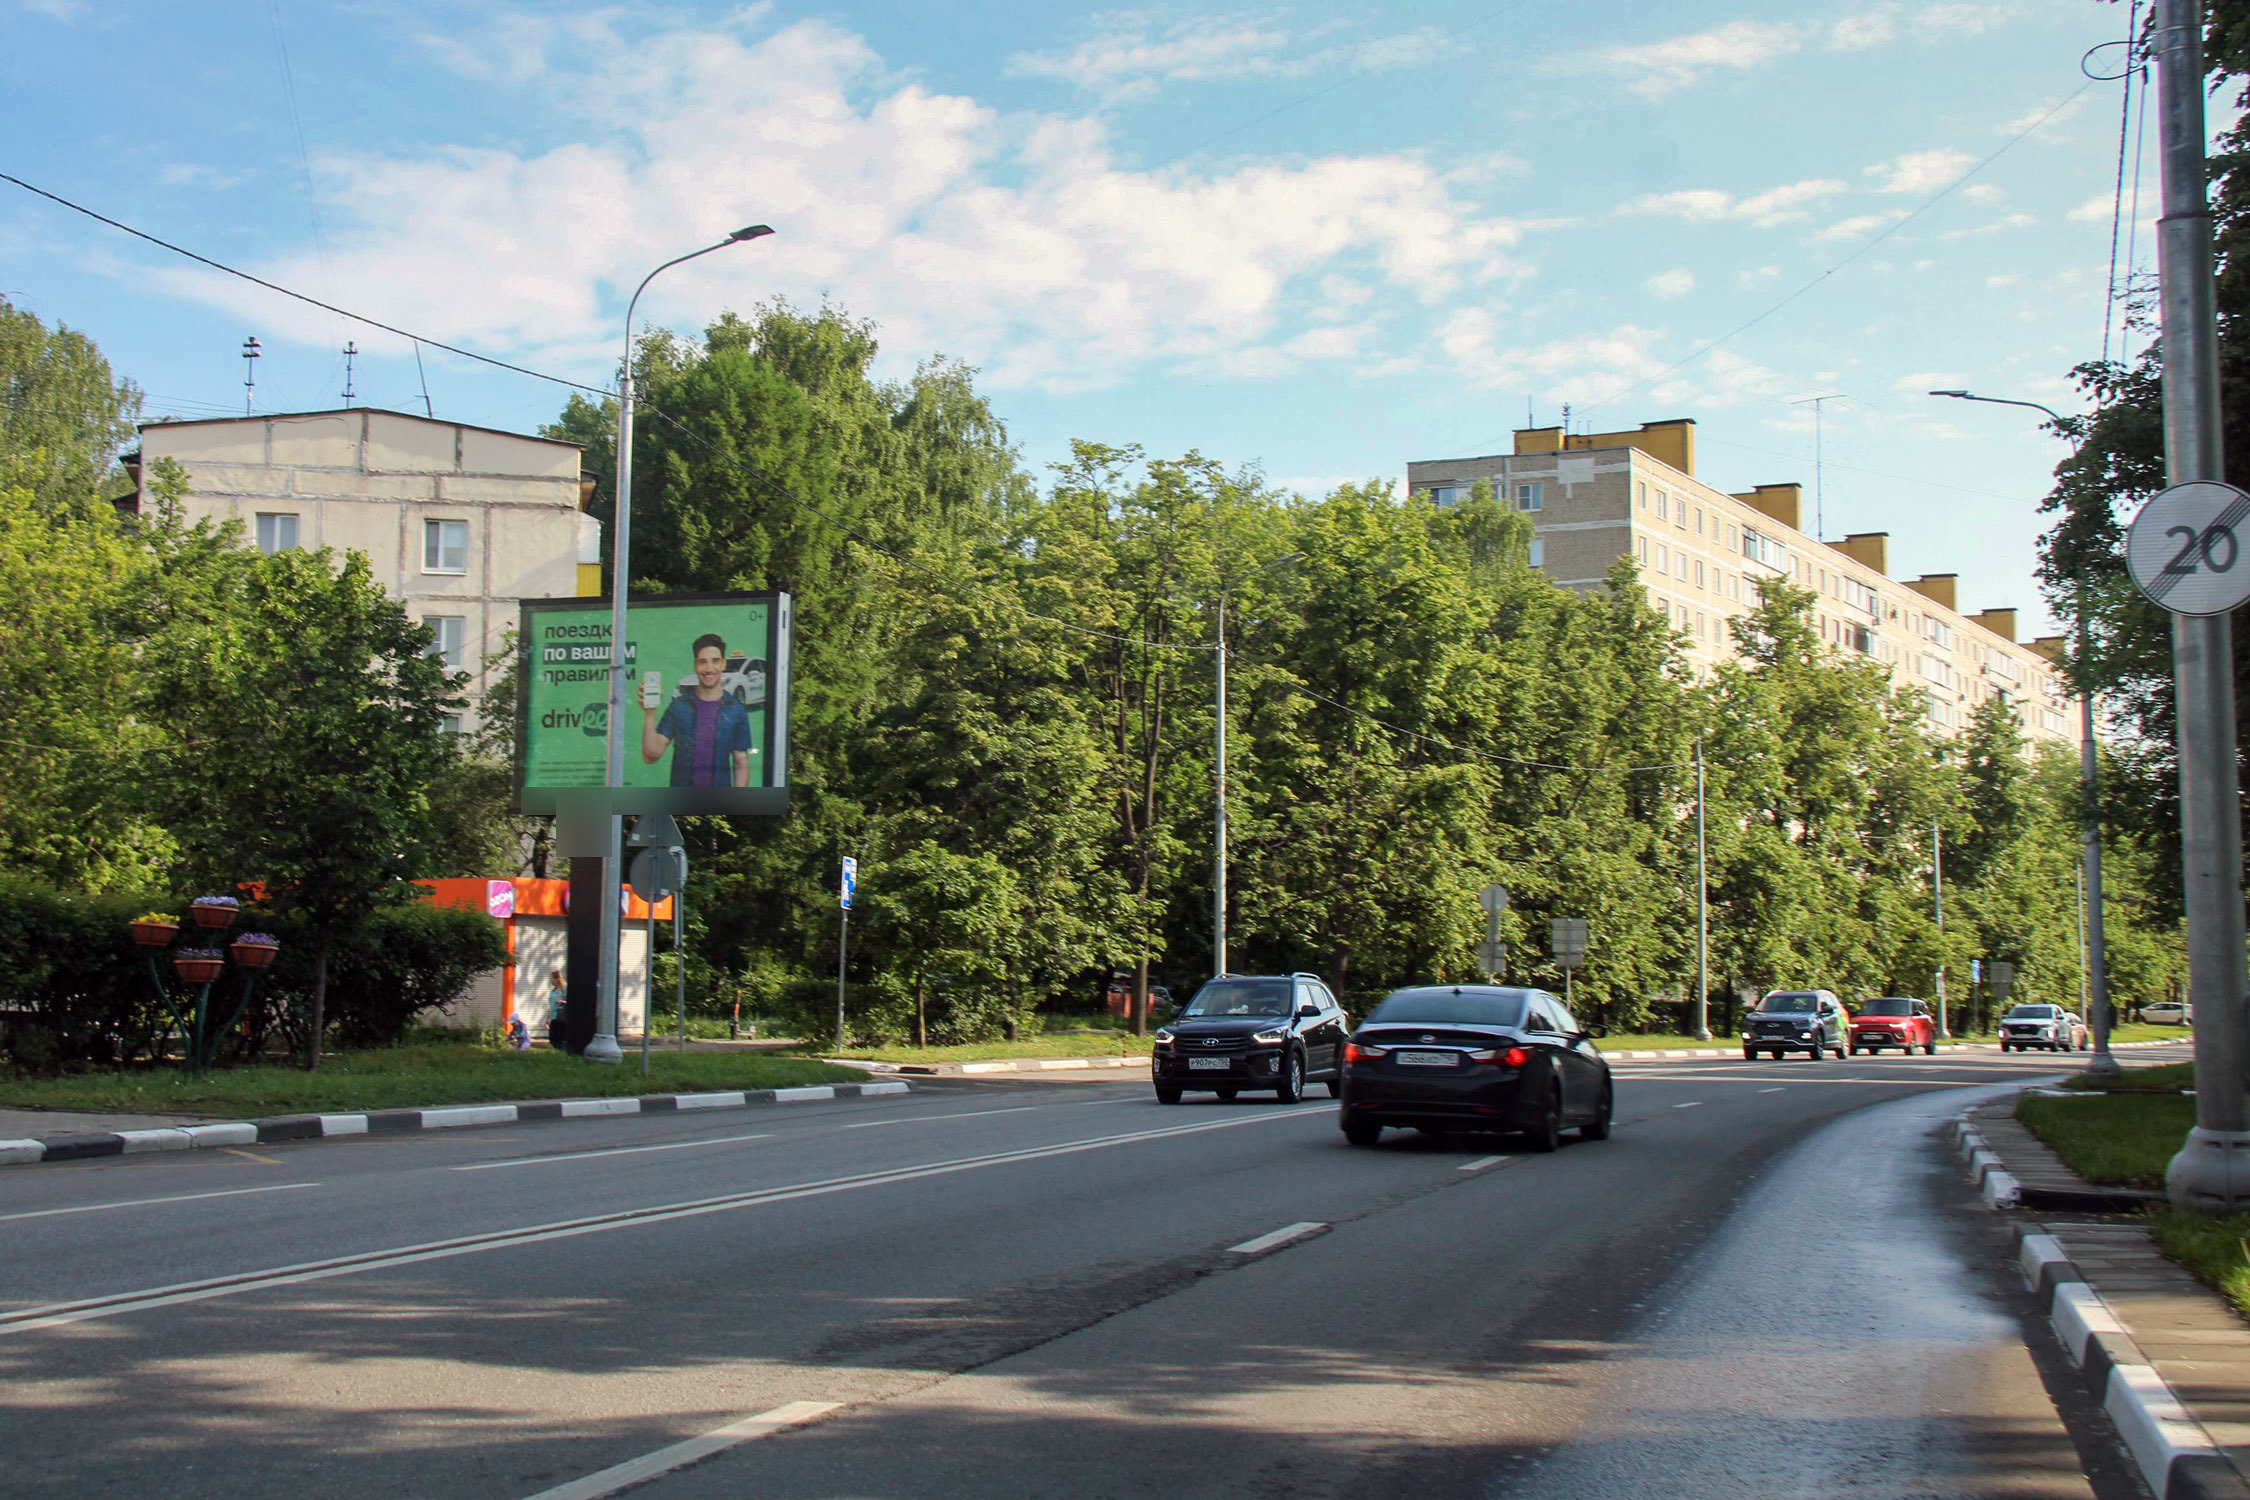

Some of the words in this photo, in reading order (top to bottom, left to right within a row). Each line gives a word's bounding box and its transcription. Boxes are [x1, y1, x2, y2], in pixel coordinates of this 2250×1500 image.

[2165, 525, 2239, 574] 20
[544, 624, 614, 640] поездк
[544, 648, 567, 662] по
[571, 645, 636, 660] вашм
[544, 668, 636, 686] правилм
